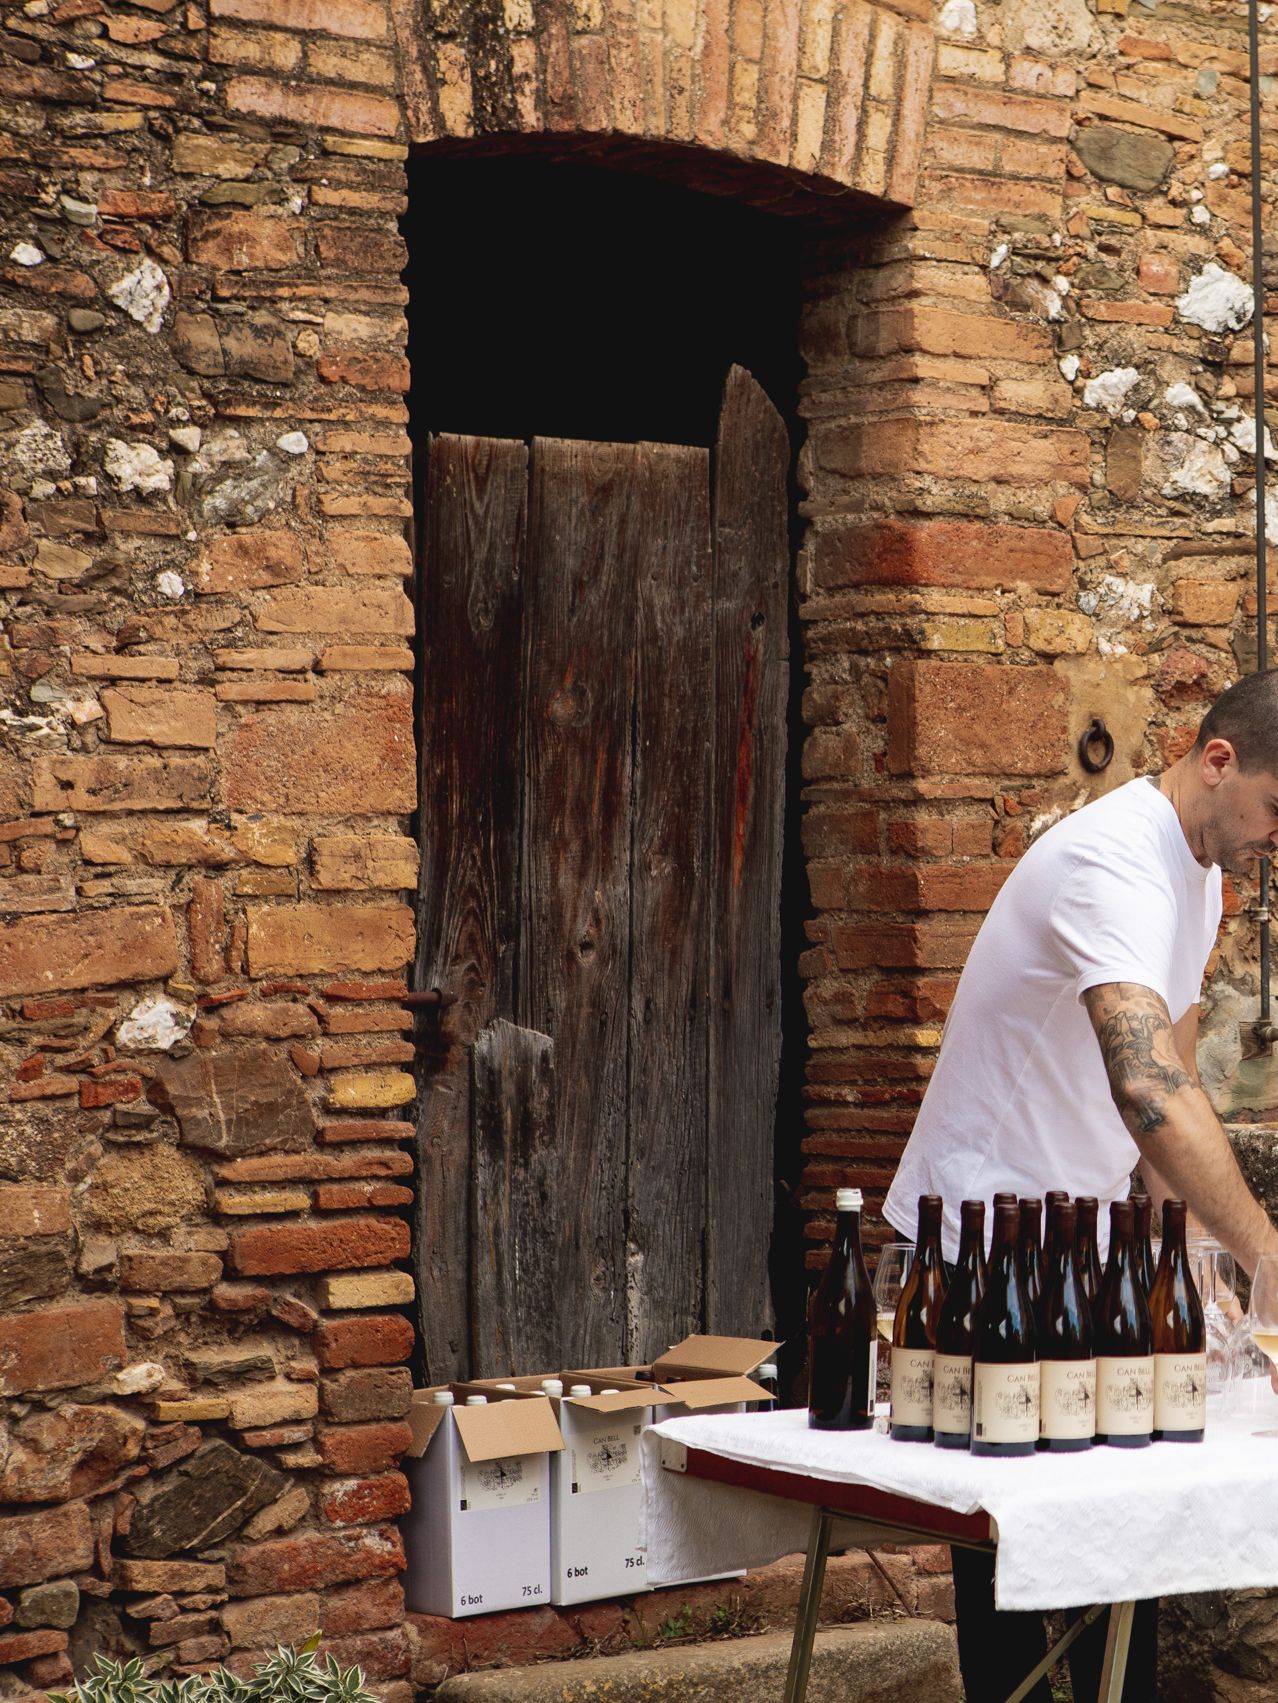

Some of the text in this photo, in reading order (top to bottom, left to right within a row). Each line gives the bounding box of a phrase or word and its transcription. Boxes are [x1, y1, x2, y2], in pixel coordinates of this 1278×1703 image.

[910, 1360, 930, 1368] CAN
[1174, 1364, 1192, 1373] CAN
[943, 1366, 961, 1374] CAN
[1116, 1367, 1136, 1376] CAN
[1007, 1375, 1026, 1384] CAN
[1066, 1371, 1085, 1380] CAN
[593, 1434, 620, 1445] CAN BELL
[625, 1556, 645, 1568] 75 cl.
[567, 1566, 588, 1578] 6 bot
[522, 1584, 543, 1597] 75 cl.
[460, 1594, 483, 1606] 6 bot
